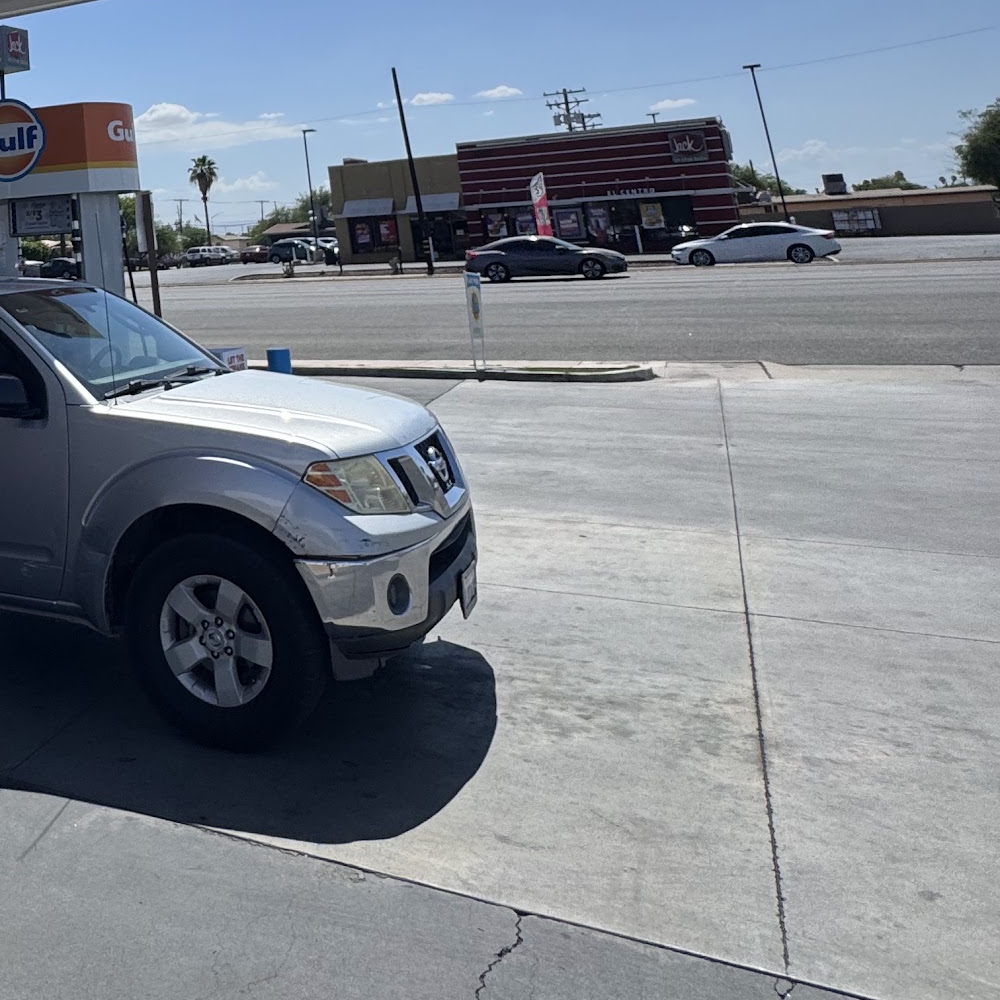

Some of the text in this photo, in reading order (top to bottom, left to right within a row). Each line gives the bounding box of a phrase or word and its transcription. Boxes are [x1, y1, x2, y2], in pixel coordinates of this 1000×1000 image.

[9, 34, 26, 55] Jack
[673, 135, 704, 153] Jack
[620, 187, 655, 196] CENTRO
